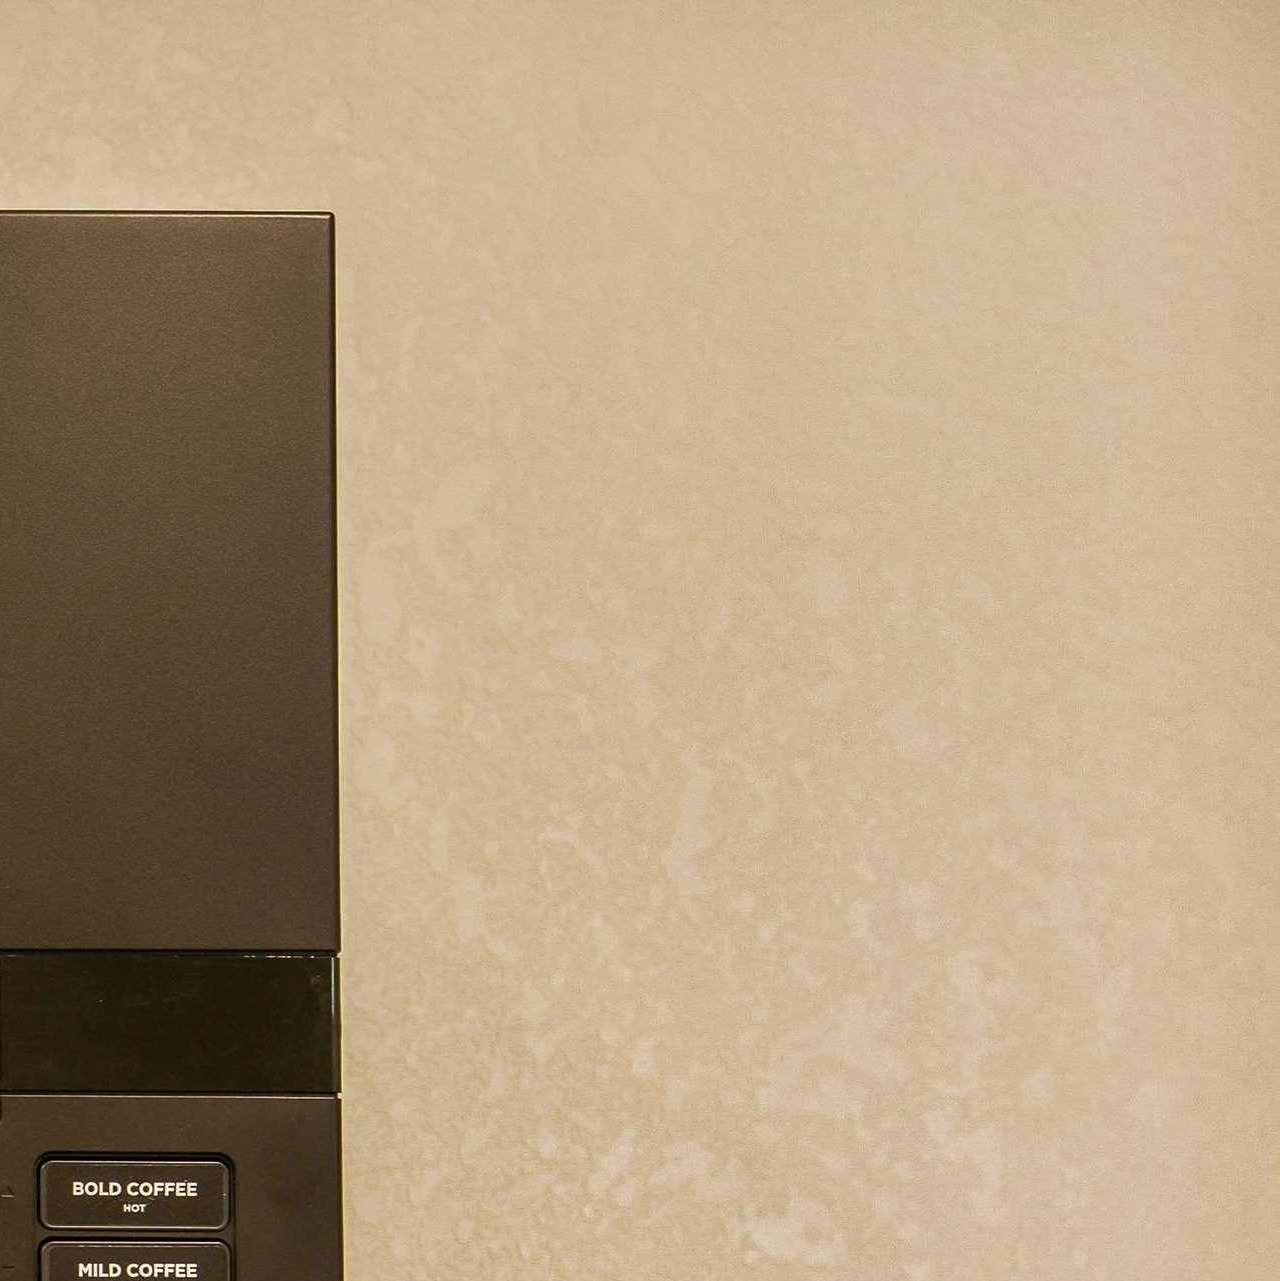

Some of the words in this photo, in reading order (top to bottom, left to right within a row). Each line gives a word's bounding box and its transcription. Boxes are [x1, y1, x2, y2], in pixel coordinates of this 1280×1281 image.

[72, 1181, 122, 1197] BOLD
[126, 1181, 198, 1197] COFFEE
[123, 1203, 147, 1213] HOT
[78, 1263, 122, 1278] MILD
[126, 1263, 198, 1278] COFFEE
